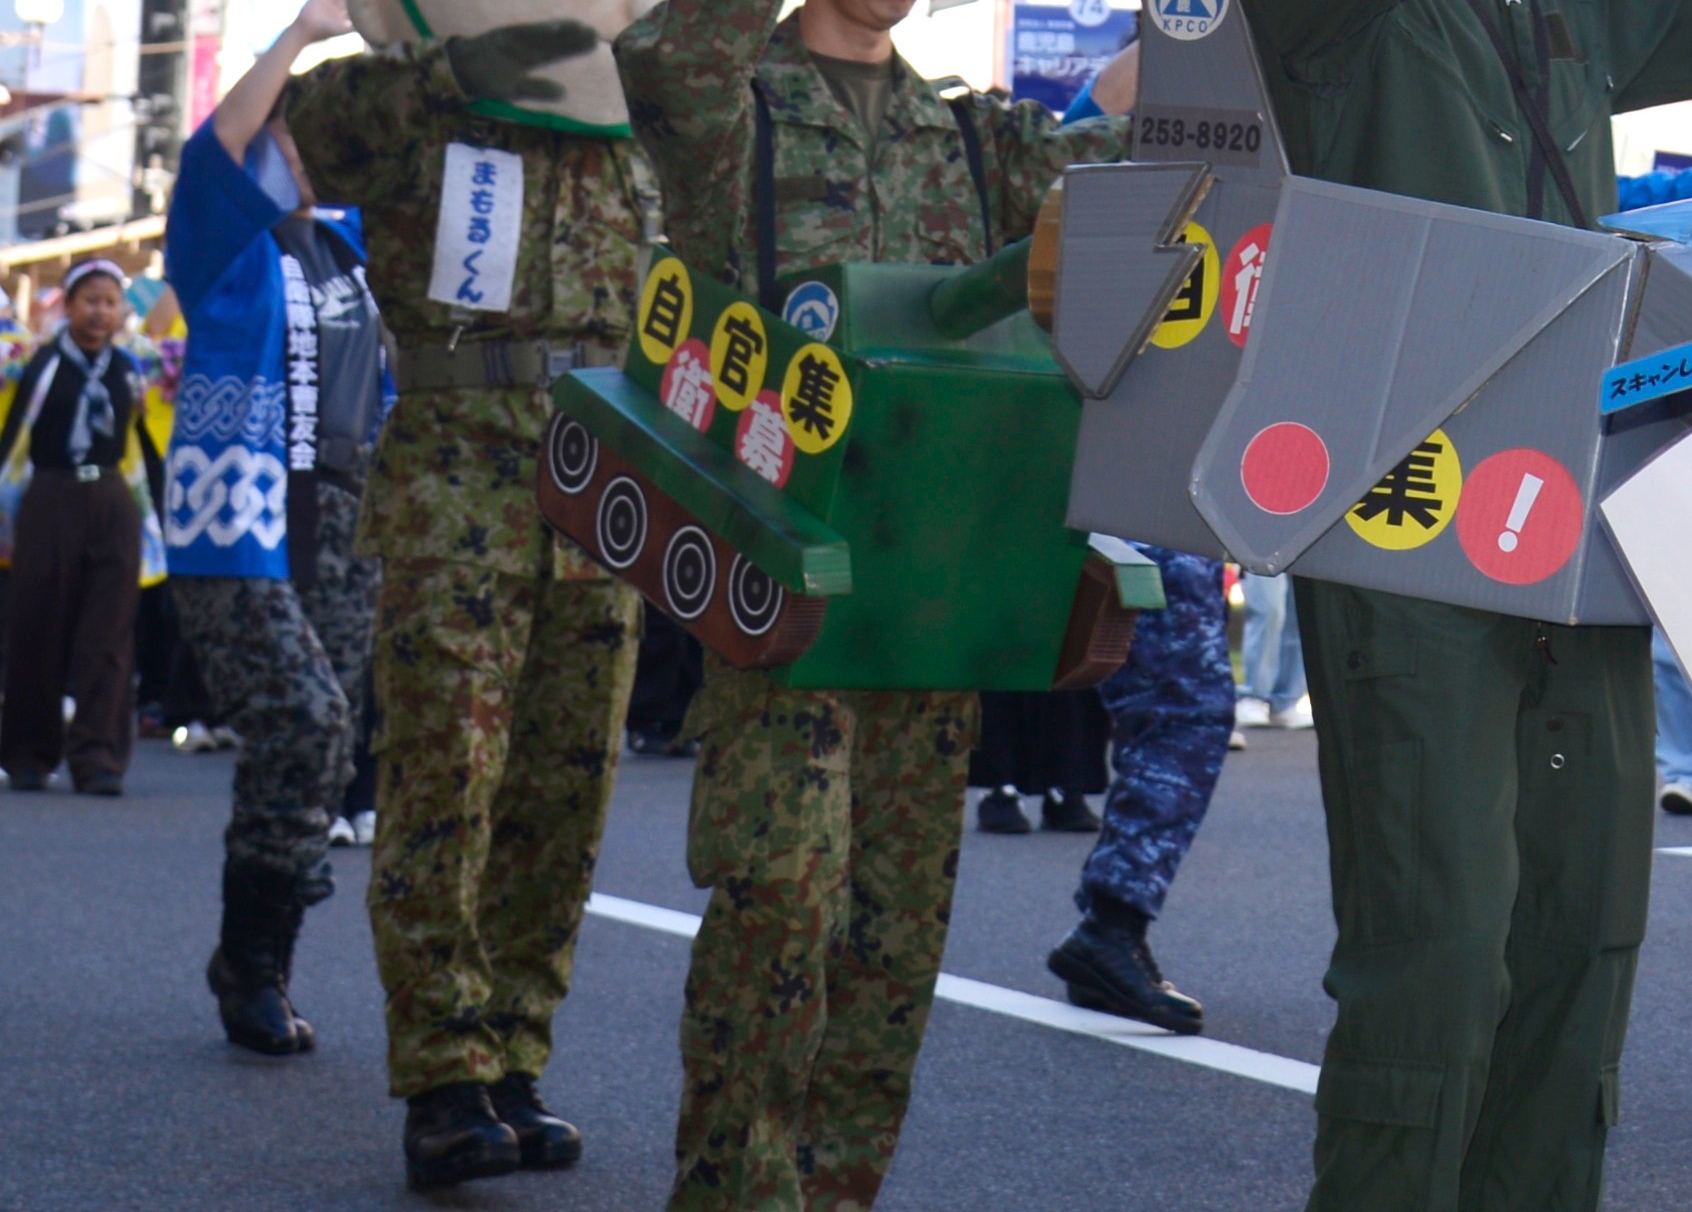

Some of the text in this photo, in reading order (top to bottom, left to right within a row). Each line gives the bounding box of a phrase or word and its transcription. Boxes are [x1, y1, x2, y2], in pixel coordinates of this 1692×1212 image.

[1162, 18, 1208, 34] KPCO
[1141, 116, 1262, 154] 253-8920
[456, 160, 497, 304] まもるくん
